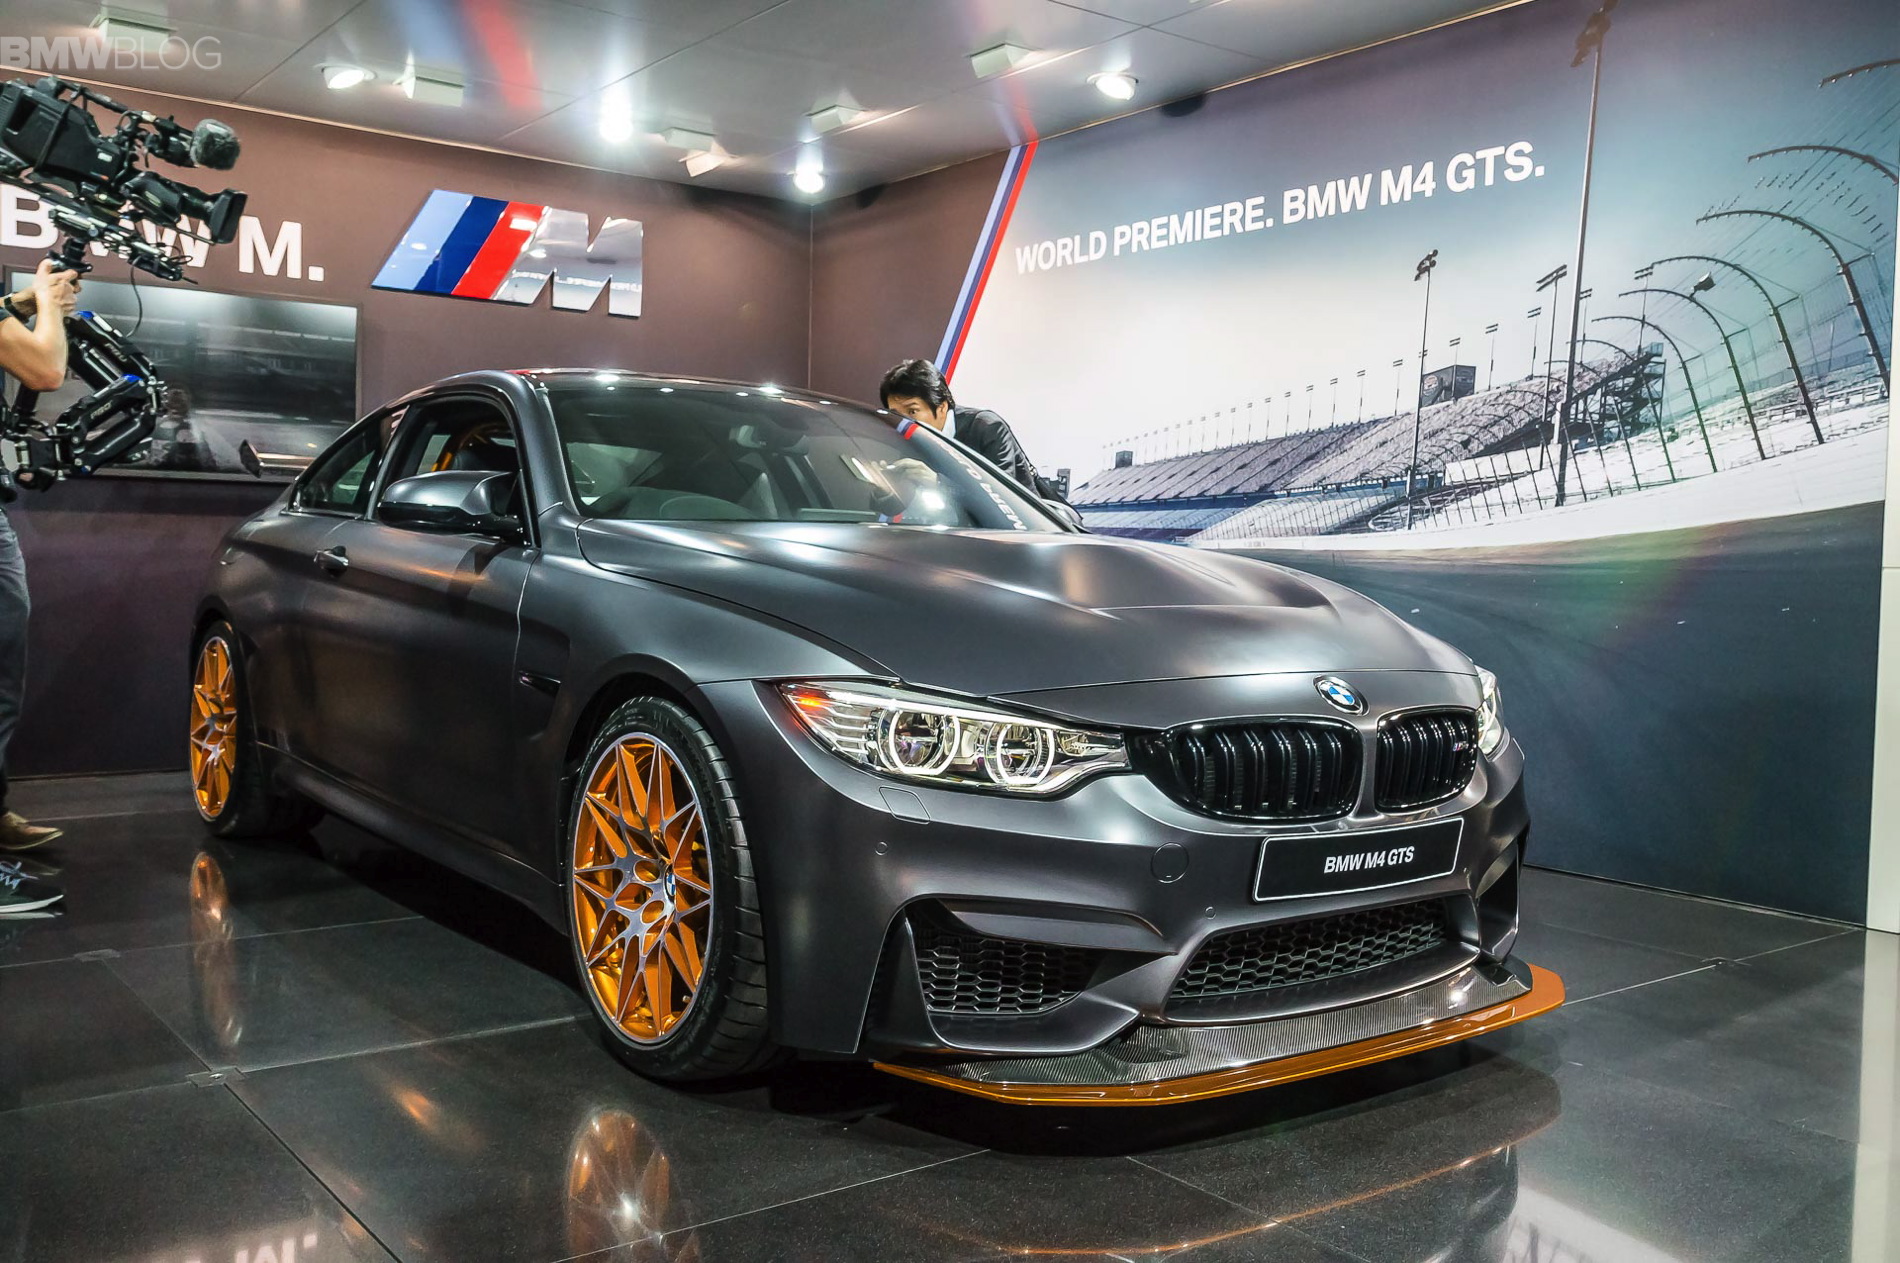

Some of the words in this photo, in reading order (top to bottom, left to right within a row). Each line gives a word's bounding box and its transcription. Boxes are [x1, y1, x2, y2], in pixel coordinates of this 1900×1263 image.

[0, 184, 213, 267] BW
[238, 215, 325, 281] M.
[1015, 230, 1107, 275] WORLD
[1113, 196, 1274, 257] PREMIERE.
[1282, 173, 1372, 225] BMW
[1380, 161, 1436, 206] M4
[1446, 141, 1545, 193] GTS.
[1323, 853, 1365, 874] BMW
[1364, 850, 1386, 869] M4
[1387, 845, 1415, 866] GTS
